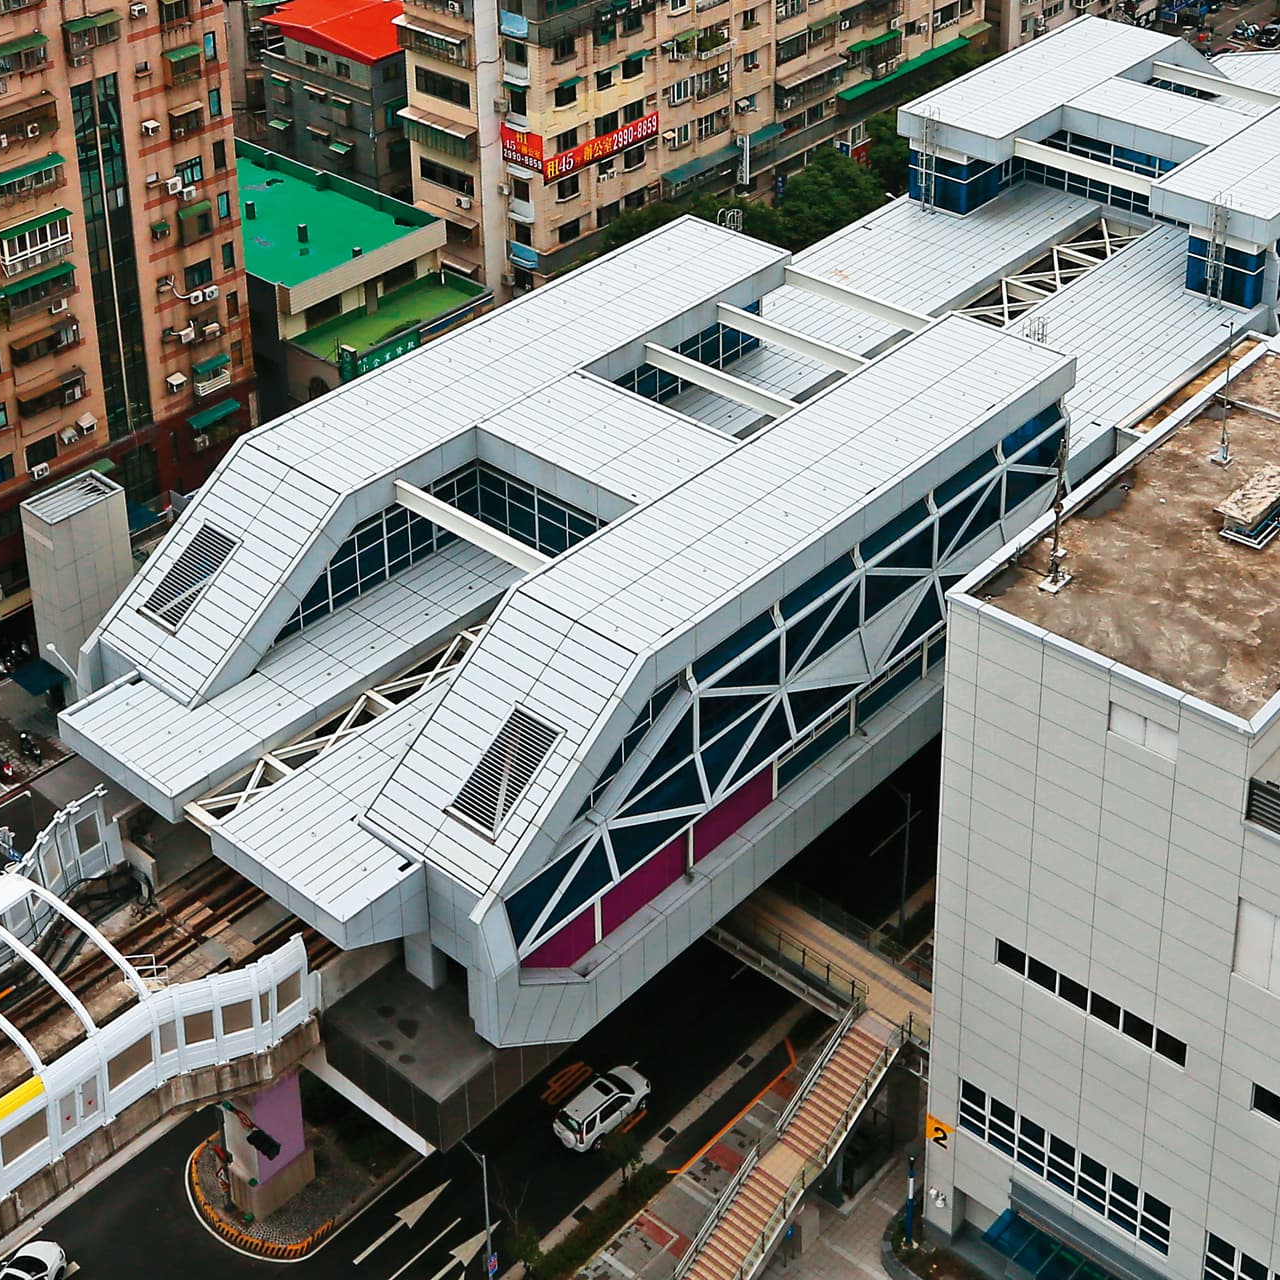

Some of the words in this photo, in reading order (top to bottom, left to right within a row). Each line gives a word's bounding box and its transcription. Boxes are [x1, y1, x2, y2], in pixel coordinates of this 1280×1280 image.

[612, 115, 657, 151] 2990-8859
[503, 148, 542, 170] 2990-8859
[933, 1126, 948, 1150] 2
